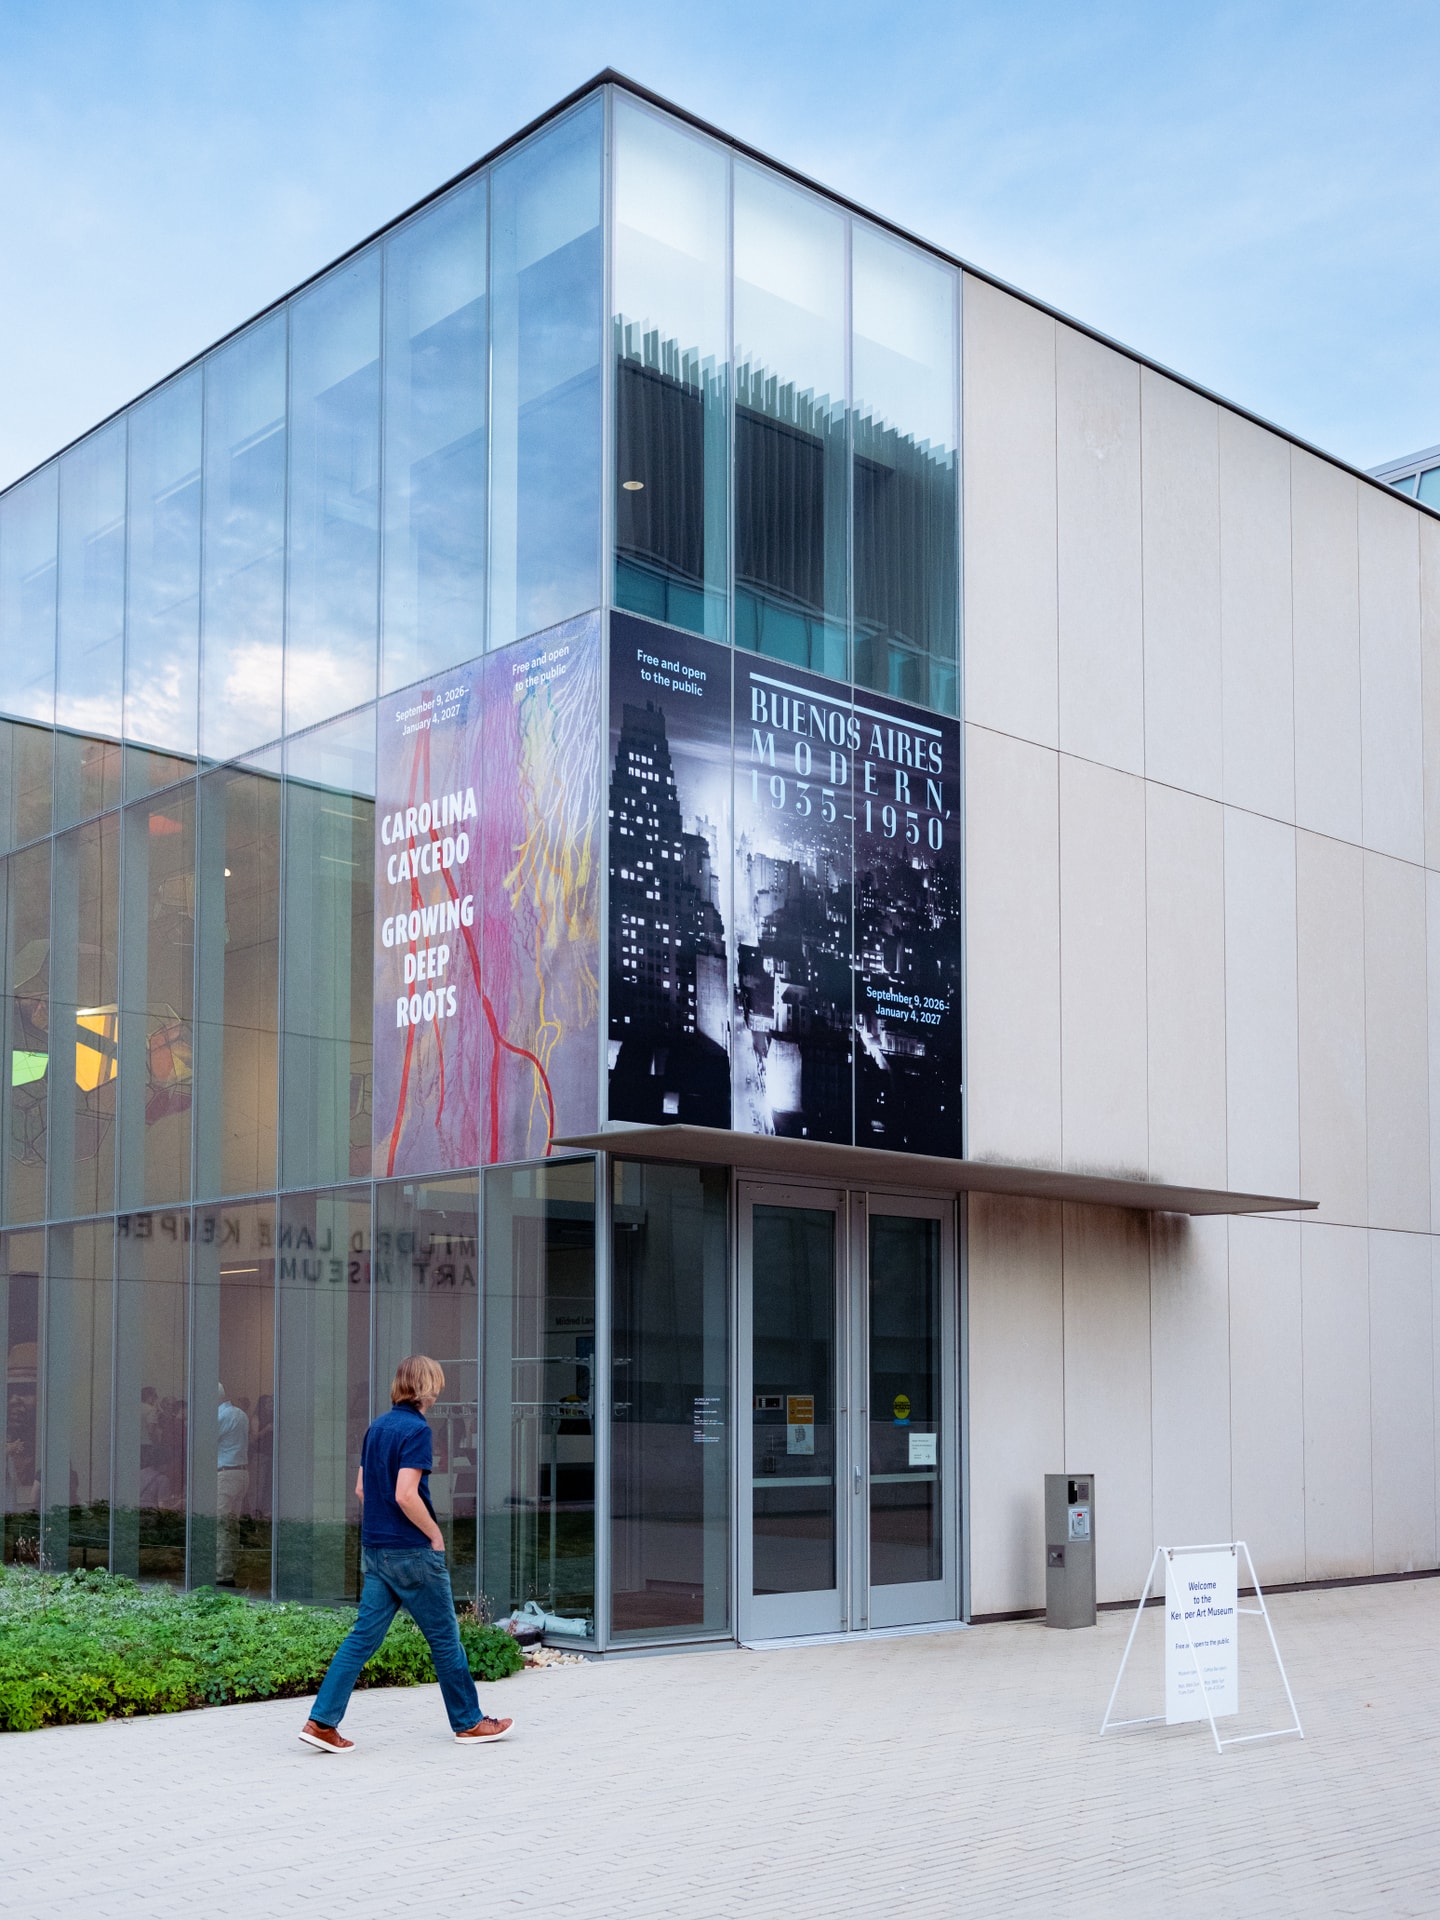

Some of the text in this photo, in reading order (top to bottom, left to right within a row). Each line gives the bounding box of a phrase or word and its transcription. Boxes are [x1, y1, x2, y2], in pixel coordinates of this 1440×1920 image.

[512, 646, 570, 676] Free and open
[637, 648, 706, 681] Free and open
[515, 663, 566, 692] to the public
[641, 668, 703, 697] to the public
[395, 699, 435, 722] September
[436, 694, 444, 706] 9,
[402, 703, 461, 736] January 4, 2027
[750, 685, 943, 775] BUENOS AIRES
[381, 787, 478, 846] CAROLINA
[387, 832, 470, 885] CAYCEDO
[382, 894, 474, 948] GROWING
[404, 944, 450, 985] DEEP
[396, 985, 457, 1028] ROOTS
[866, 986, 912, 1005] September
[913, 995, 922, 1008] 9,
[875, 1003, 941, 1025] January 4, 2027
[1188, 1581, 1217, 1591] Welcome
[1193, 1594, 1212, 1604] to the
[1196, 1608, 1206, 1618] Art
[1207, 1607, 1234, 1616] Museum
